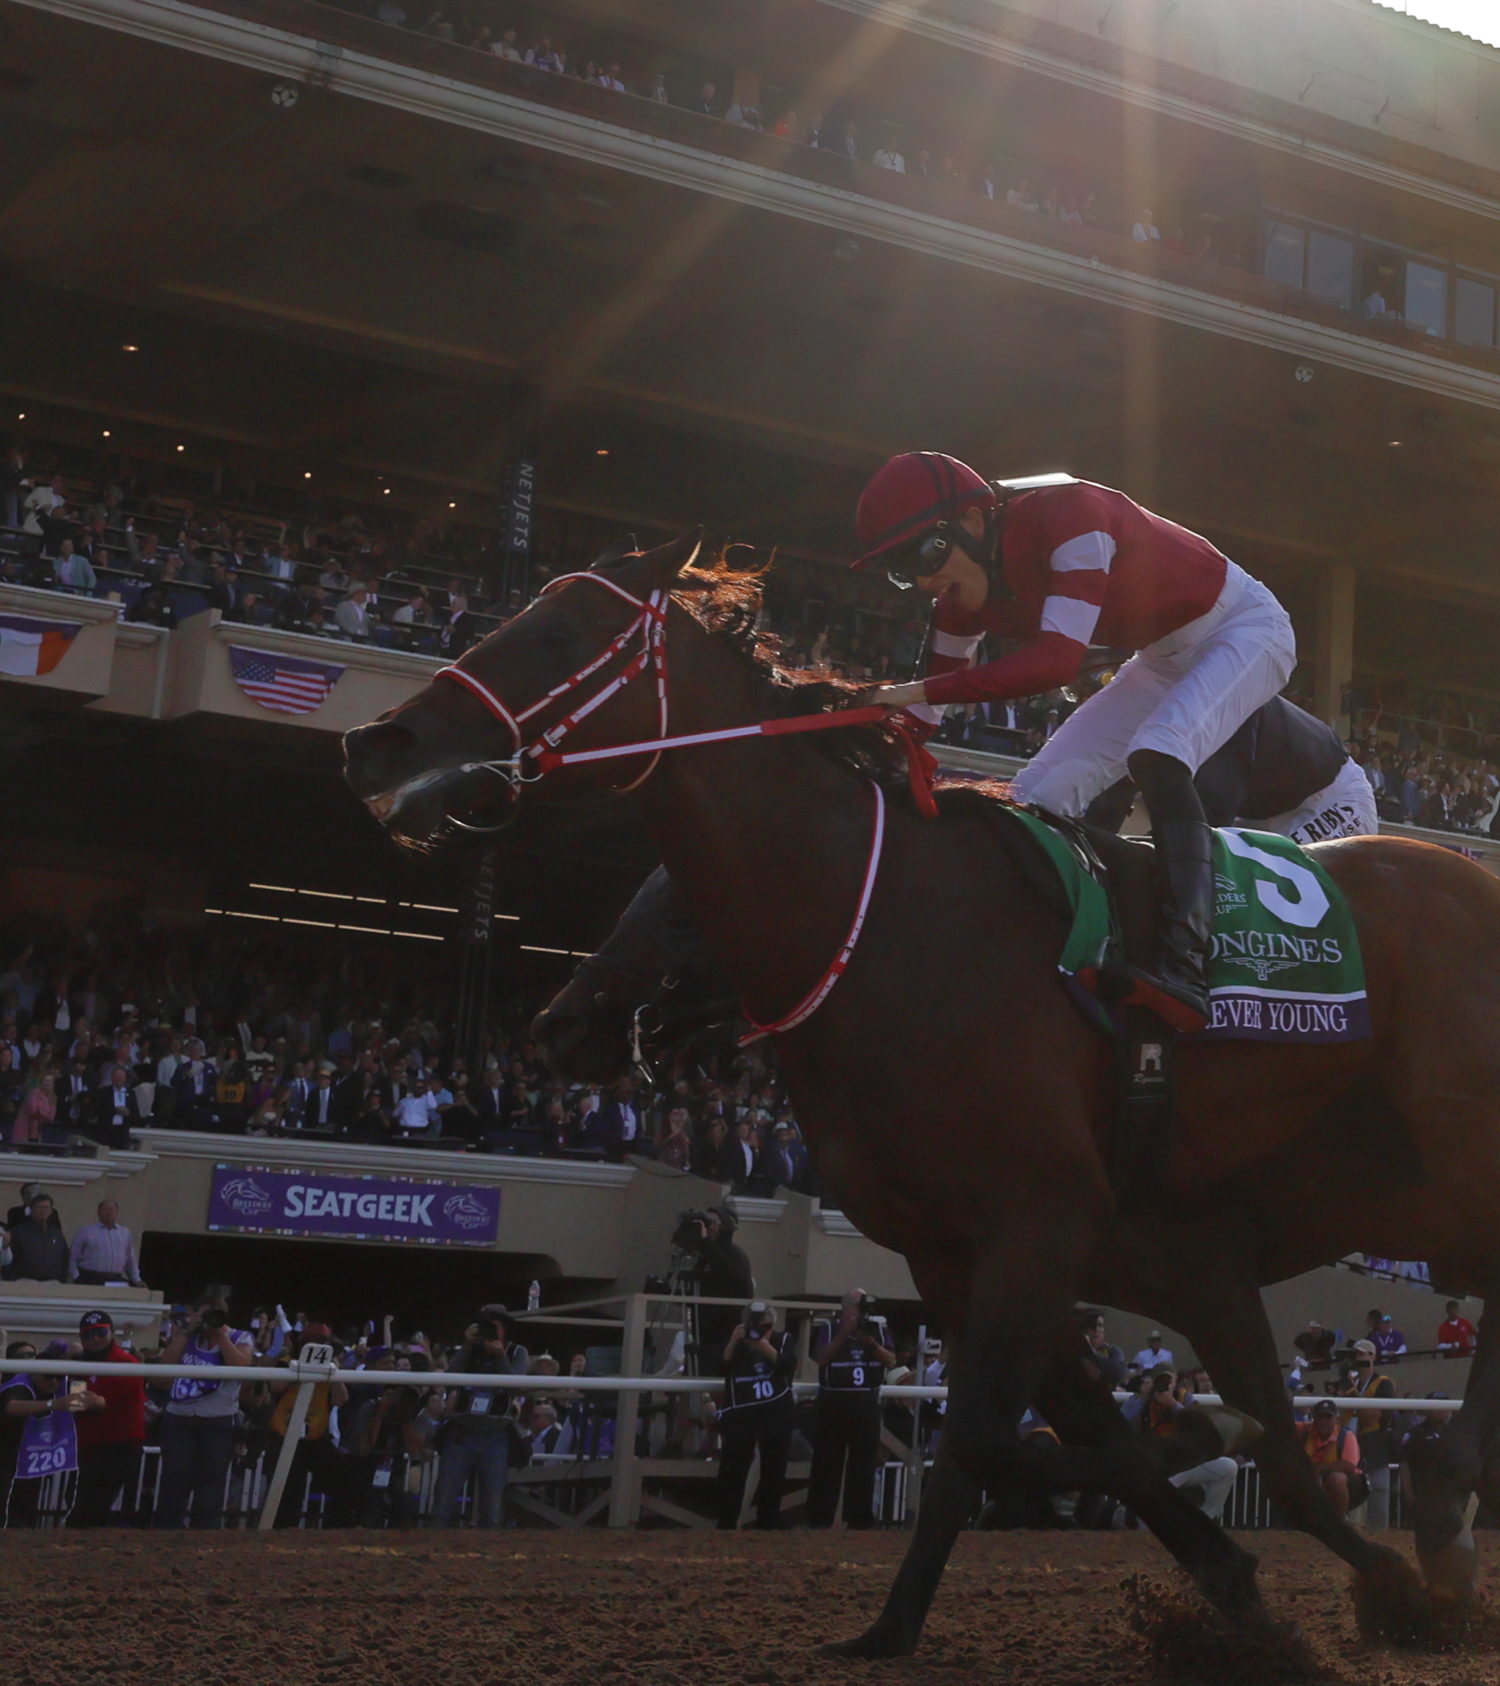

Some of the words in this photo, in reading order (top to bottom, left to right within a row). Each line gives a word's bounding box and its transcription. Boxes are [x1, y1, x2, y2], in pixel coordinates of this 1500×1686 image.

[512, 463, 535, 548] NETJETS
[1269, 1002, 1348, 1033] YOUNG
[283, 1185, 436, 1227] SEATGEEK
[305, 1347, 328, 1364] 14
[852, 1367, 865, 1386] 9
[752, 1380, 774, 1400] 10
[27, 1447, 66, 1473] 220
